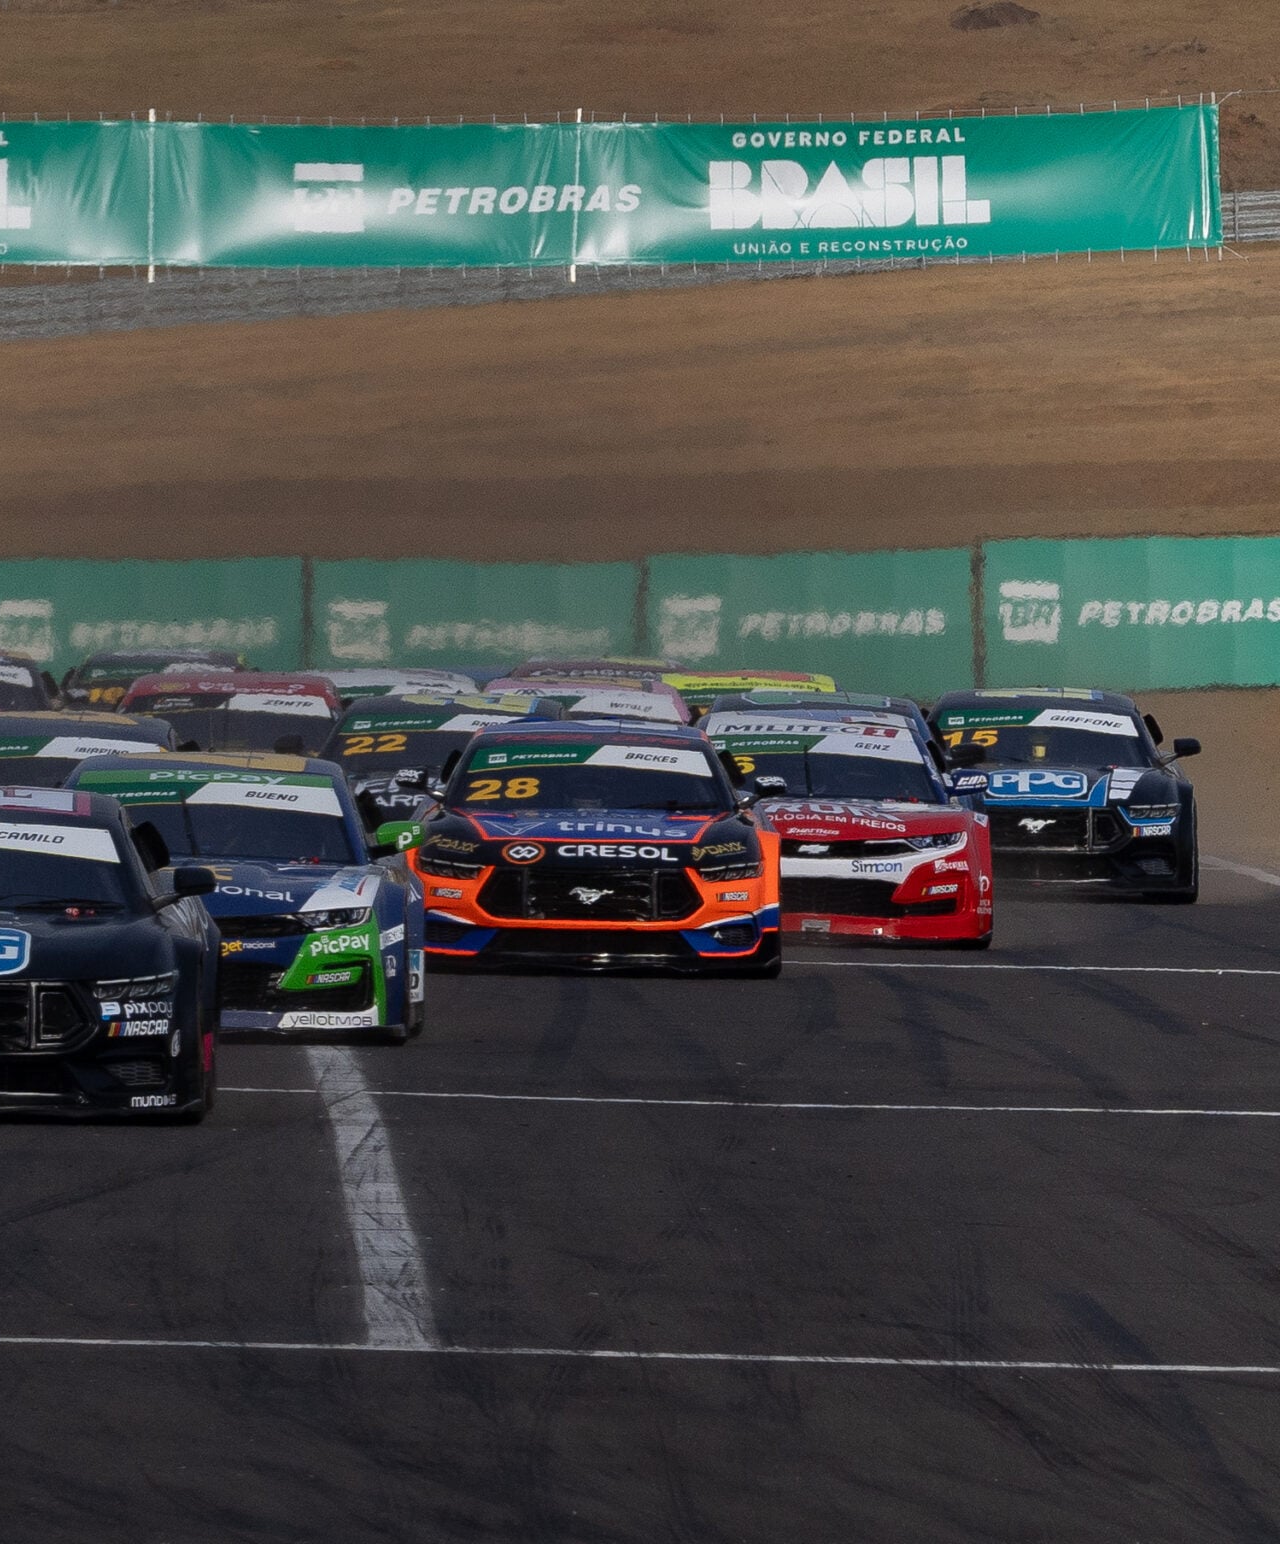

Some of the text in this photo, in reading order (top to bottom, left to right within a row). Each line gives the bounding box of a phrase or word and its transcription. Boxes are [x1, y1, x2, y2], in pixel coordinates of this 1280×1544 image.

[732, 127, 966, 148] GOVERNO FEDERAL
[388, 184, 642, 215] PETROBRAS
[709, 155, 991, 230] BRASIL
[734, 235, 968, 255] UNIÃO E RECONSTRUÇÃO
[724, 724, 861, 734] MILITEC
[1050, 714, 1123, 729] GIAFFONE
[343, 734, 407, 756] 22
[854, 742, 891, 751] GENZ
[943, 730, 998, 748] 15
[512, 752, 578, 760] PETROBRAS
[624, 752, 679, 764] BACKES
[149, 770, 287, 787] PicPay
[992, 771, 1081, 793] PPG
[245, 790, 299, 803] BUENO
[466, 777, 540, 801] 28
[557, 820, 688, 837] trinus
[825, 815, 847, 823] EM
[852, 817, 907, 833] FREIOS
[1142, 825, 1172, 836] NASCAR
[398, 832, 413, 849] P
[558, 844, 679, 861] CRESOL
[851, 860, 903, 873] Simcon
[310, 933, 370, 957] PicPay
[317, 971, 352, 984] NASCAR
[123, 1000, 174, 1019] pixpay
[124, 1019, 169, 1036] NASCAR
